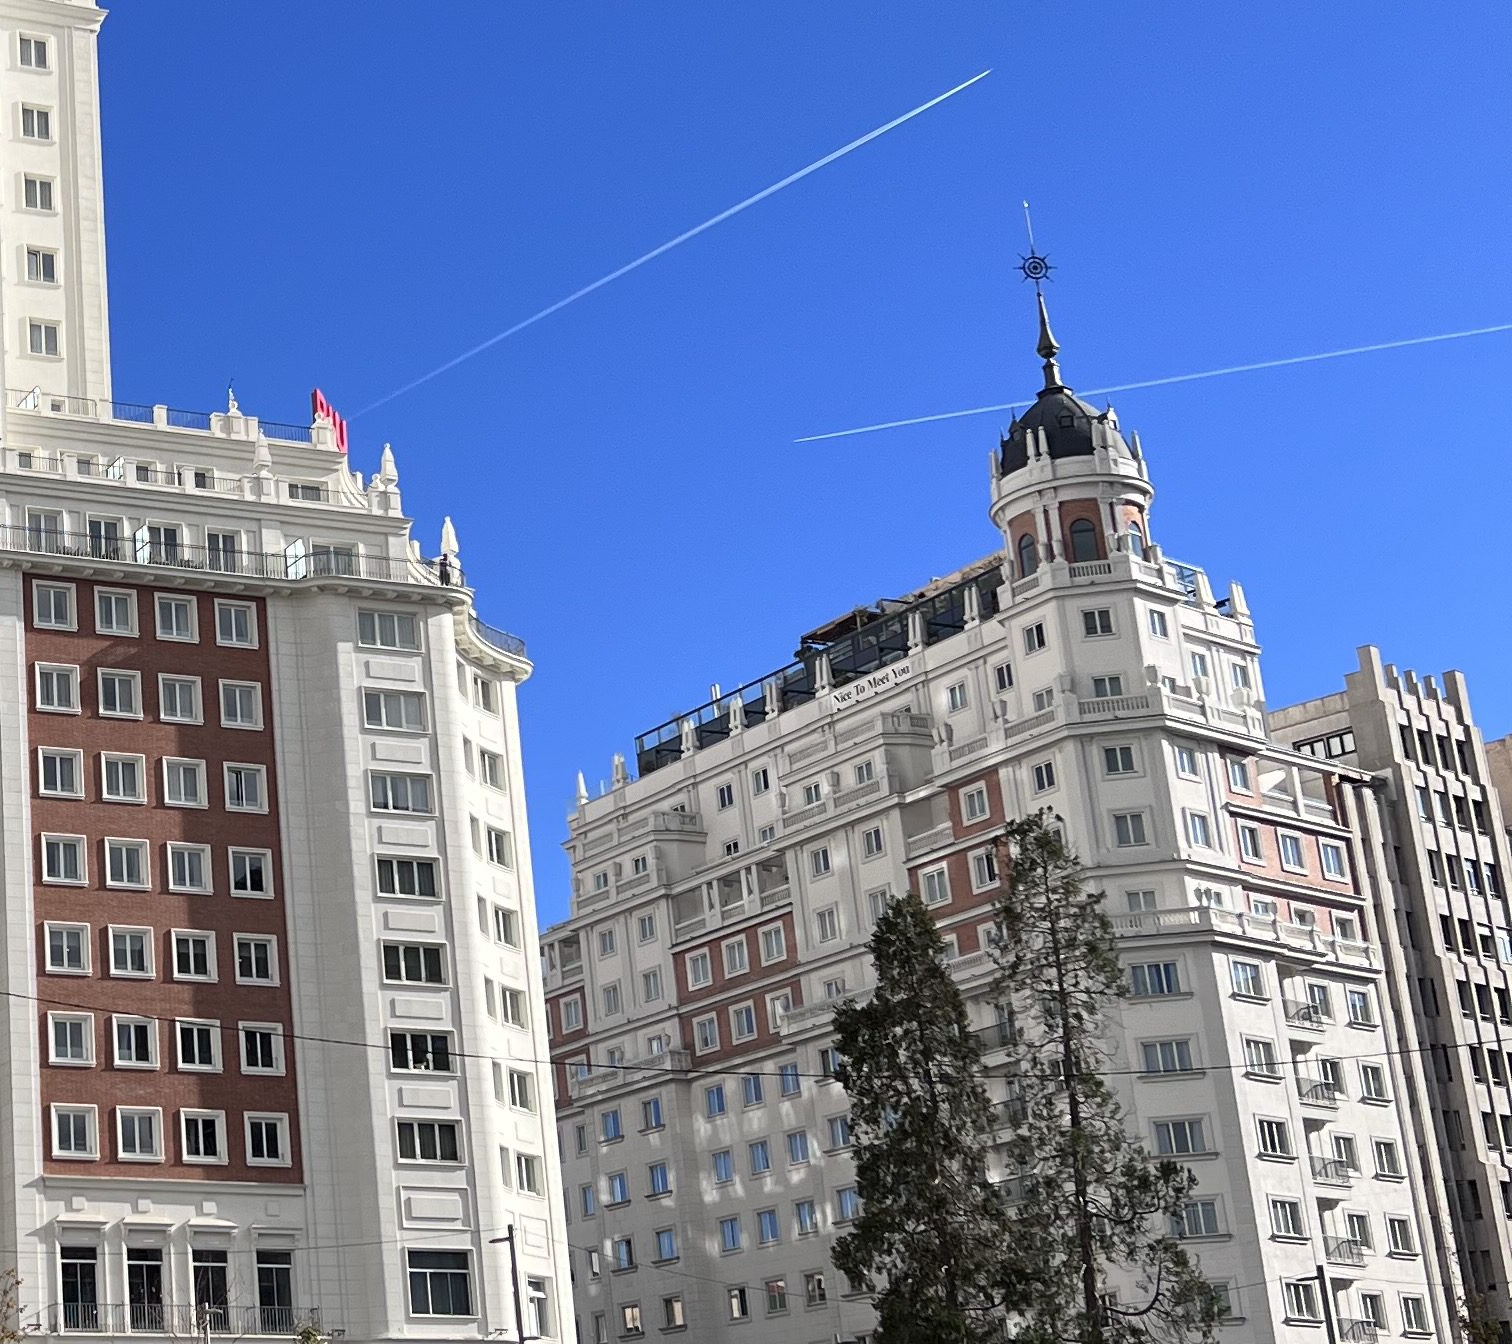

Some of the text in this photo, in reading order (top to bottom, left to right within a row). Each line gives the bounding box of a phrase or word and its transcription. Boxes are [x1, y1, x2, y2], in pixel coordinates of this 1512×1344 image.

[833, 664, 910, 704] Nice To Meet You
